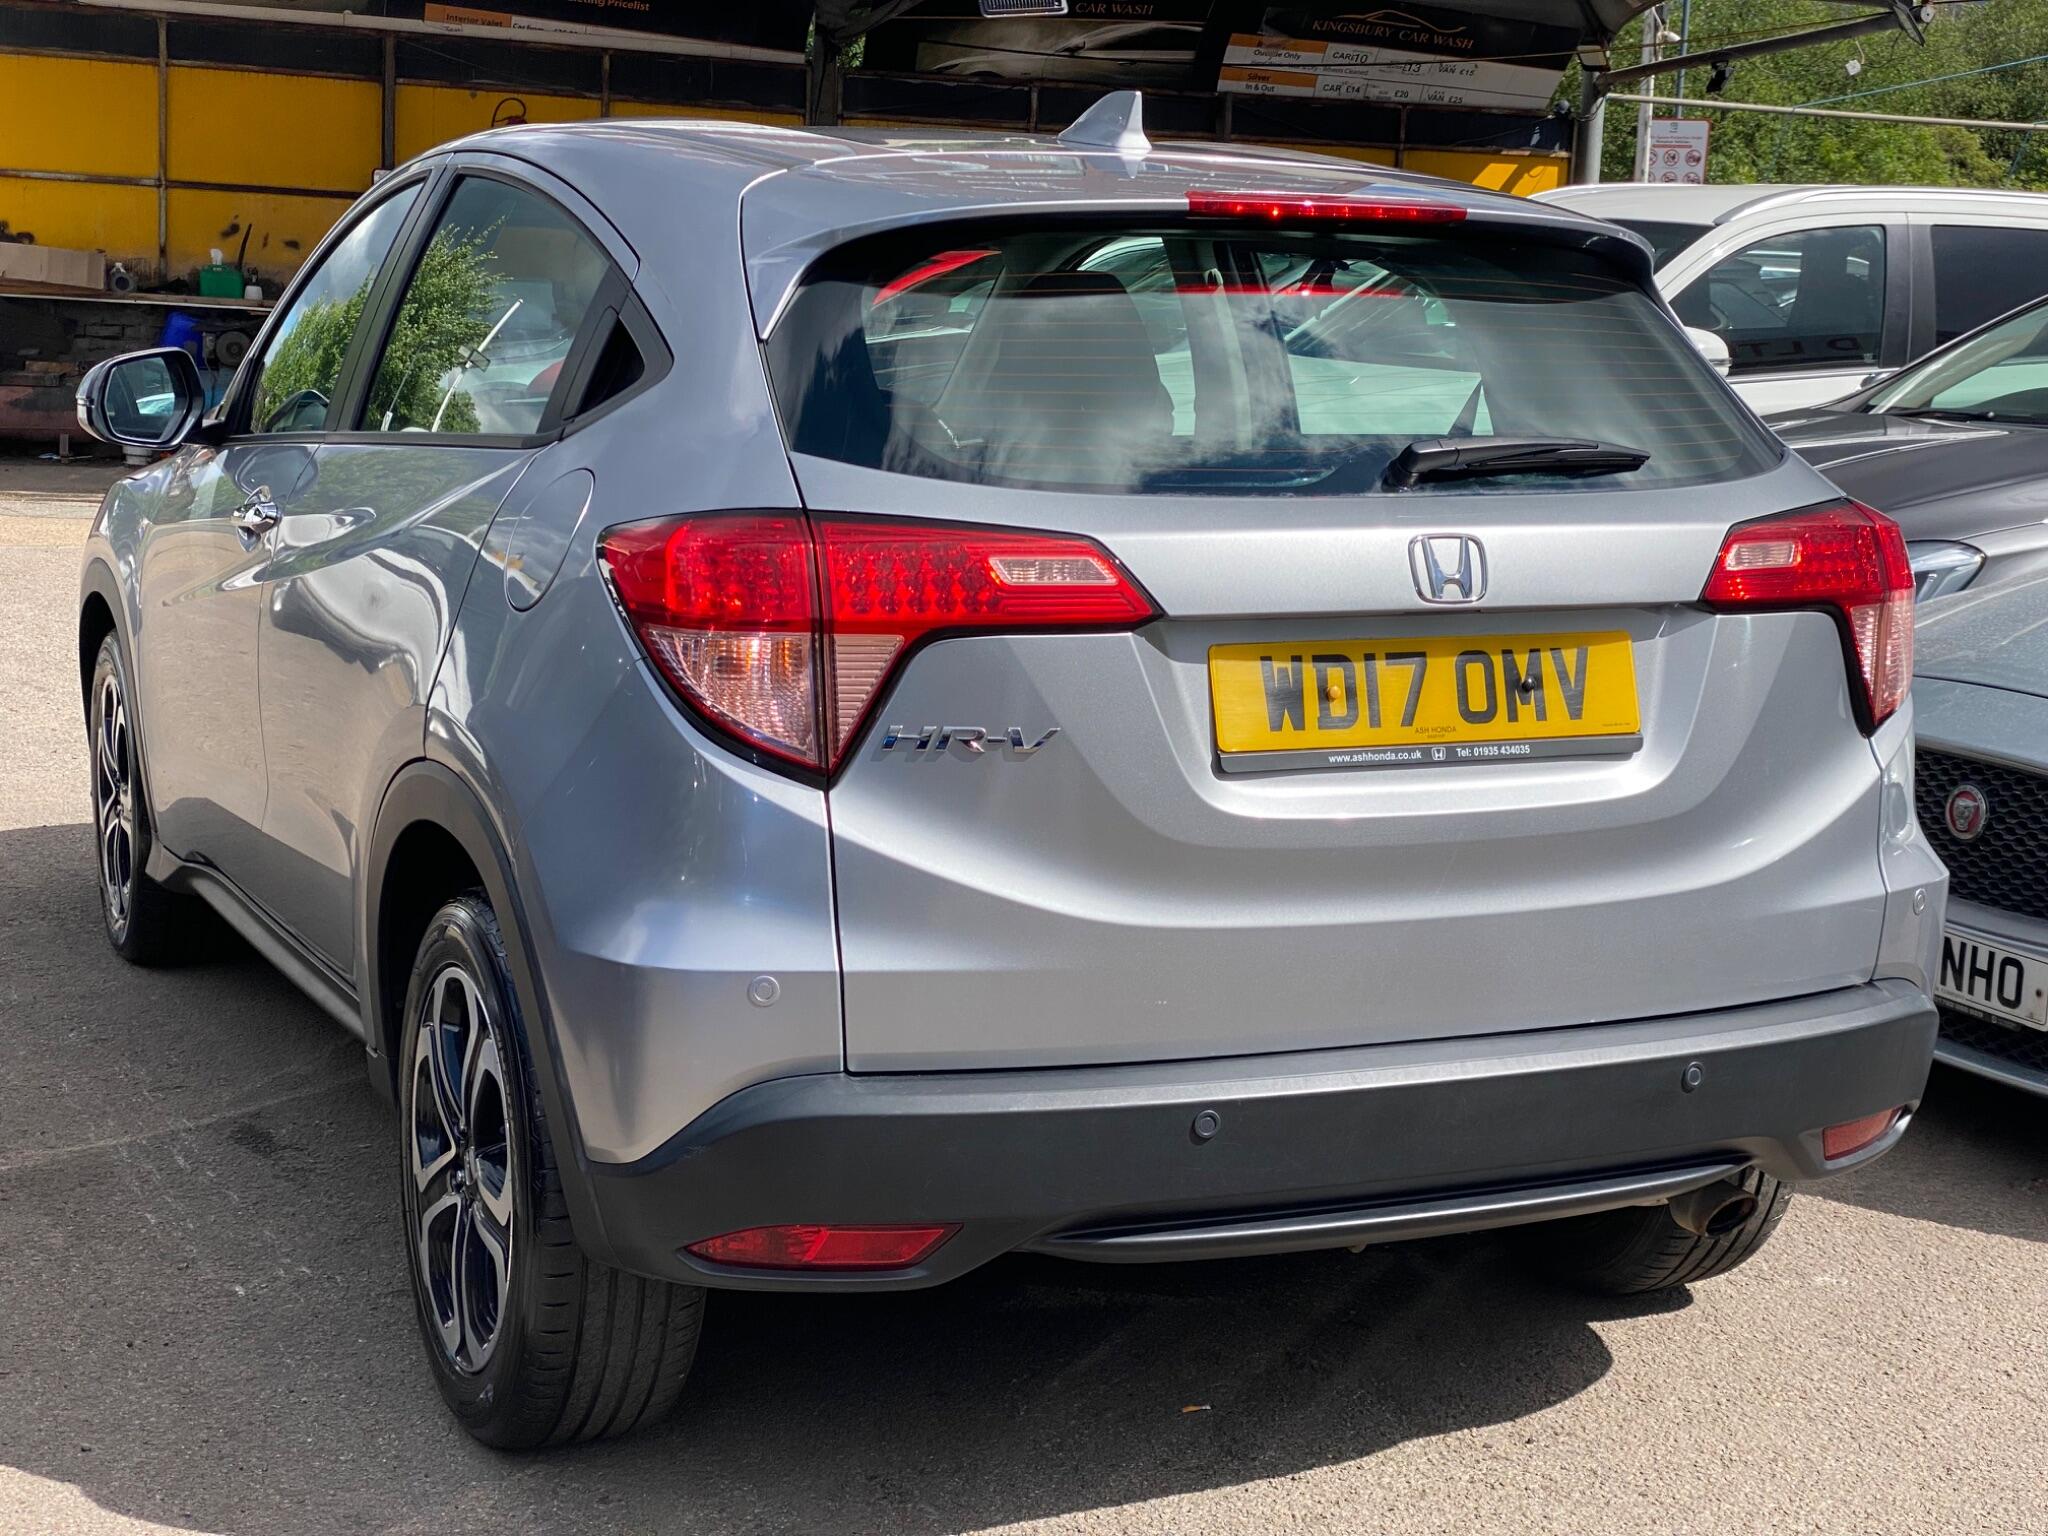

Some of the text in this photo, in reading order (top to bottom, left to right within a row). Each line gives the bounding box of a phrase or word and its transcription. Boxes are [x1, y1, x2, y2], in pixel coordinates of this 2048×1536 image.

[607, 0, 651, 11] Pricelist
[1076, 2, 1153, 15] CAR WASH
[446, 13, 503, 27] Interior Valet
[1311, 19, 1475, 49] KINGSBURY CAR WASH
[1284, 52, 1302, 60] Only
[1247, 72, 1270, 81] Silver
[1323, 84, 1361, 94] CAR £14
[1395, 90, 1409, 98] £20
[1427, 93, 1464, 104] VAN £25
[1260, 647, 1589, 732] WD17 OMV
[1414, 726, 1457, 735] ASH HONDA
[882, 724, 1061, 753] HR-V
[1456, 745, 1531, 757] Tel: 01935 434035
[1329, 752, 1422, 763] www.ashhonda.co.uk
[1940, 936, 2024, 1010] NHO
